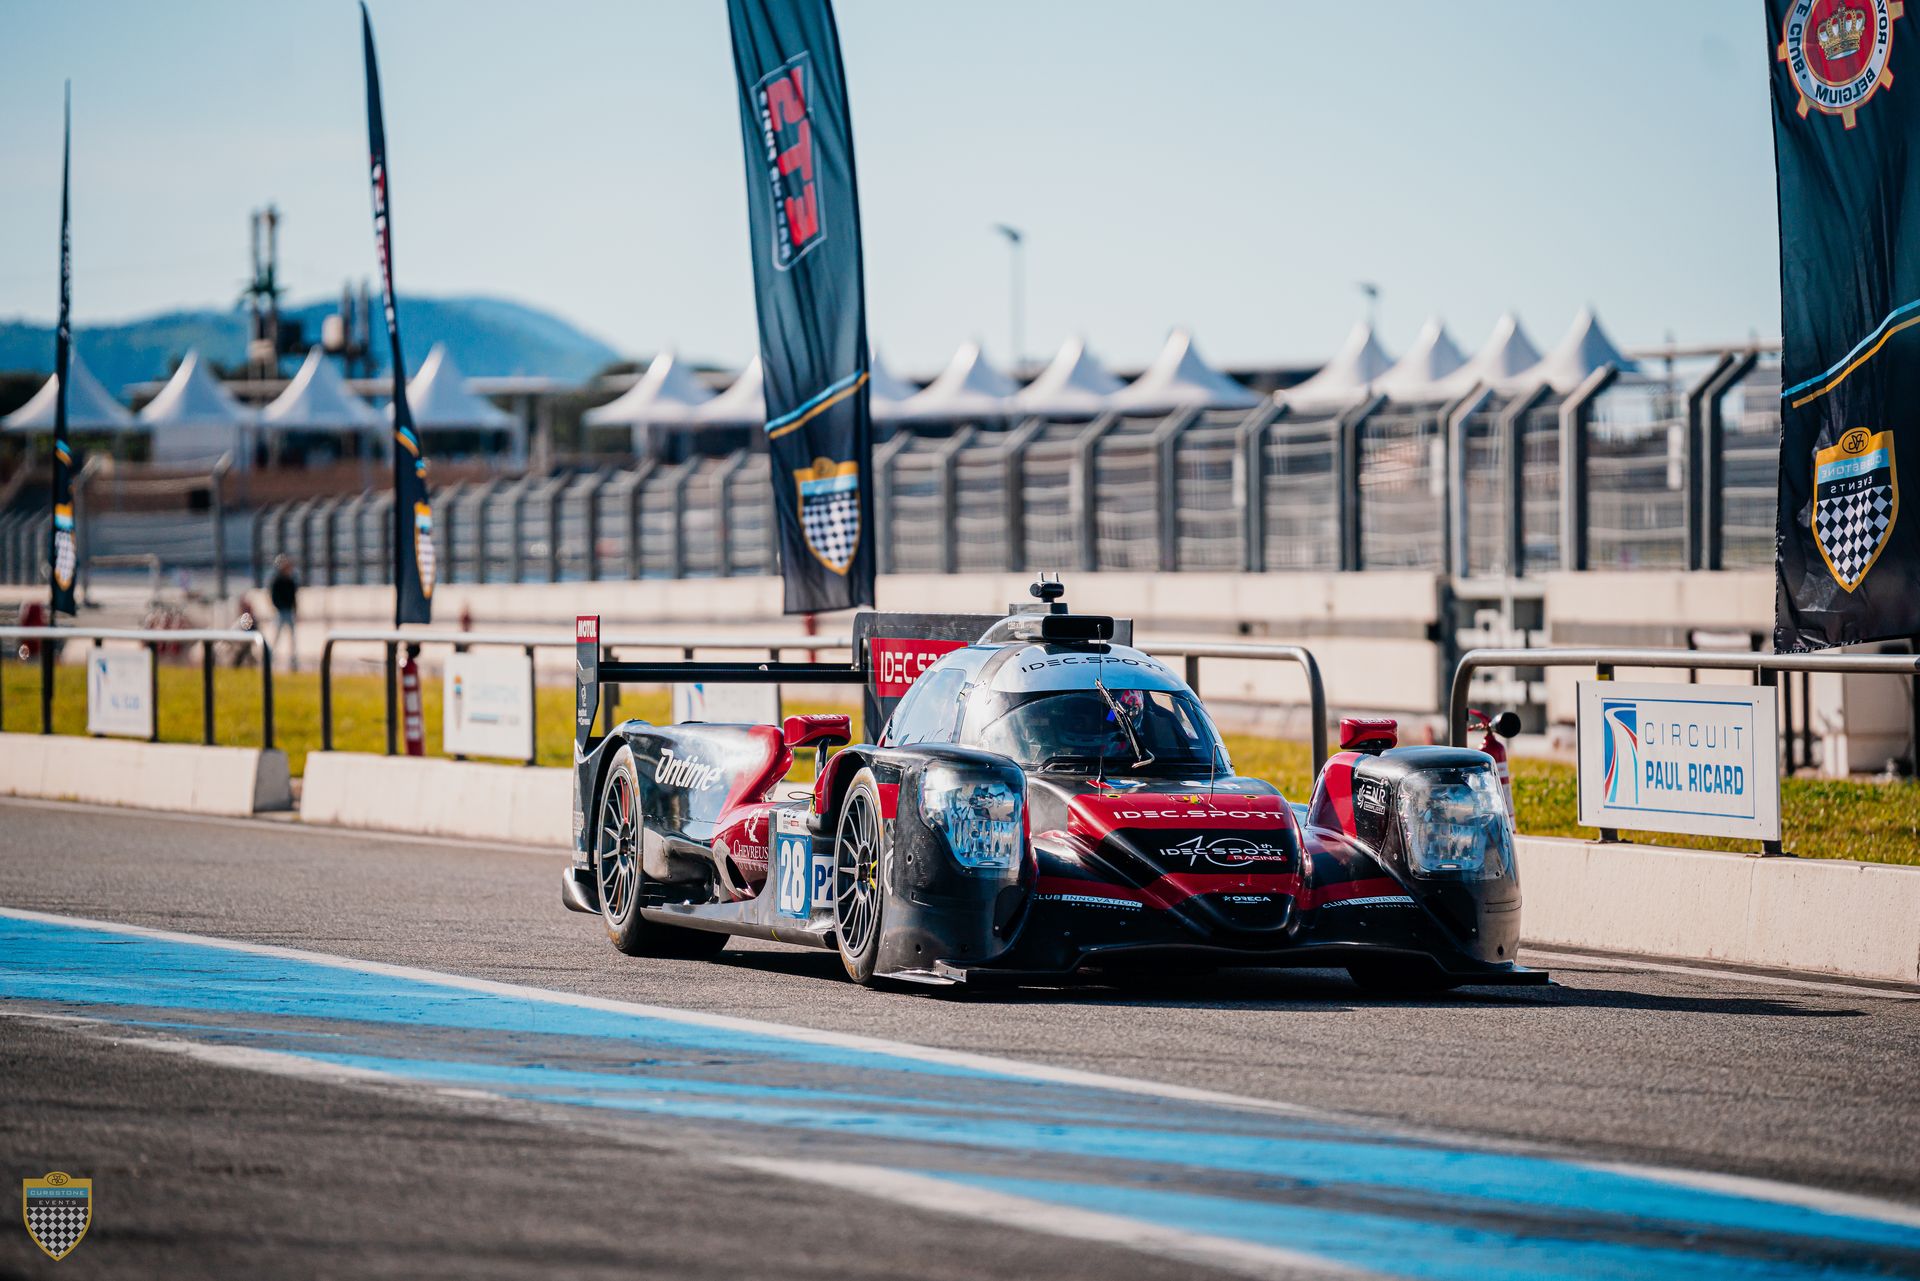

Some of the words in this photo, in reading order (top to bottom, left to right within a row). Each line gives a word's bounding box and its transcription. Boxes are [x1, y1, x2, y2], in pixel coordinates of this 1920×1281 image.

[577, 620, 596, 637] MOTUL
[1644, 722, 1743, 750] CIRCUIT
[1646, 760, 1682, 791] PAUL
[1688, 763, 1744, 795] RICARD
[1113, 810, 1284, 820] IDEC.SPORT
[733, 839, 768, 860] CHEVREUS
[781, 840, 806, 912] 28
[1065, 895, 1139, 906] INNOVATION
[1322, 900, 1349, 909] CLUB
